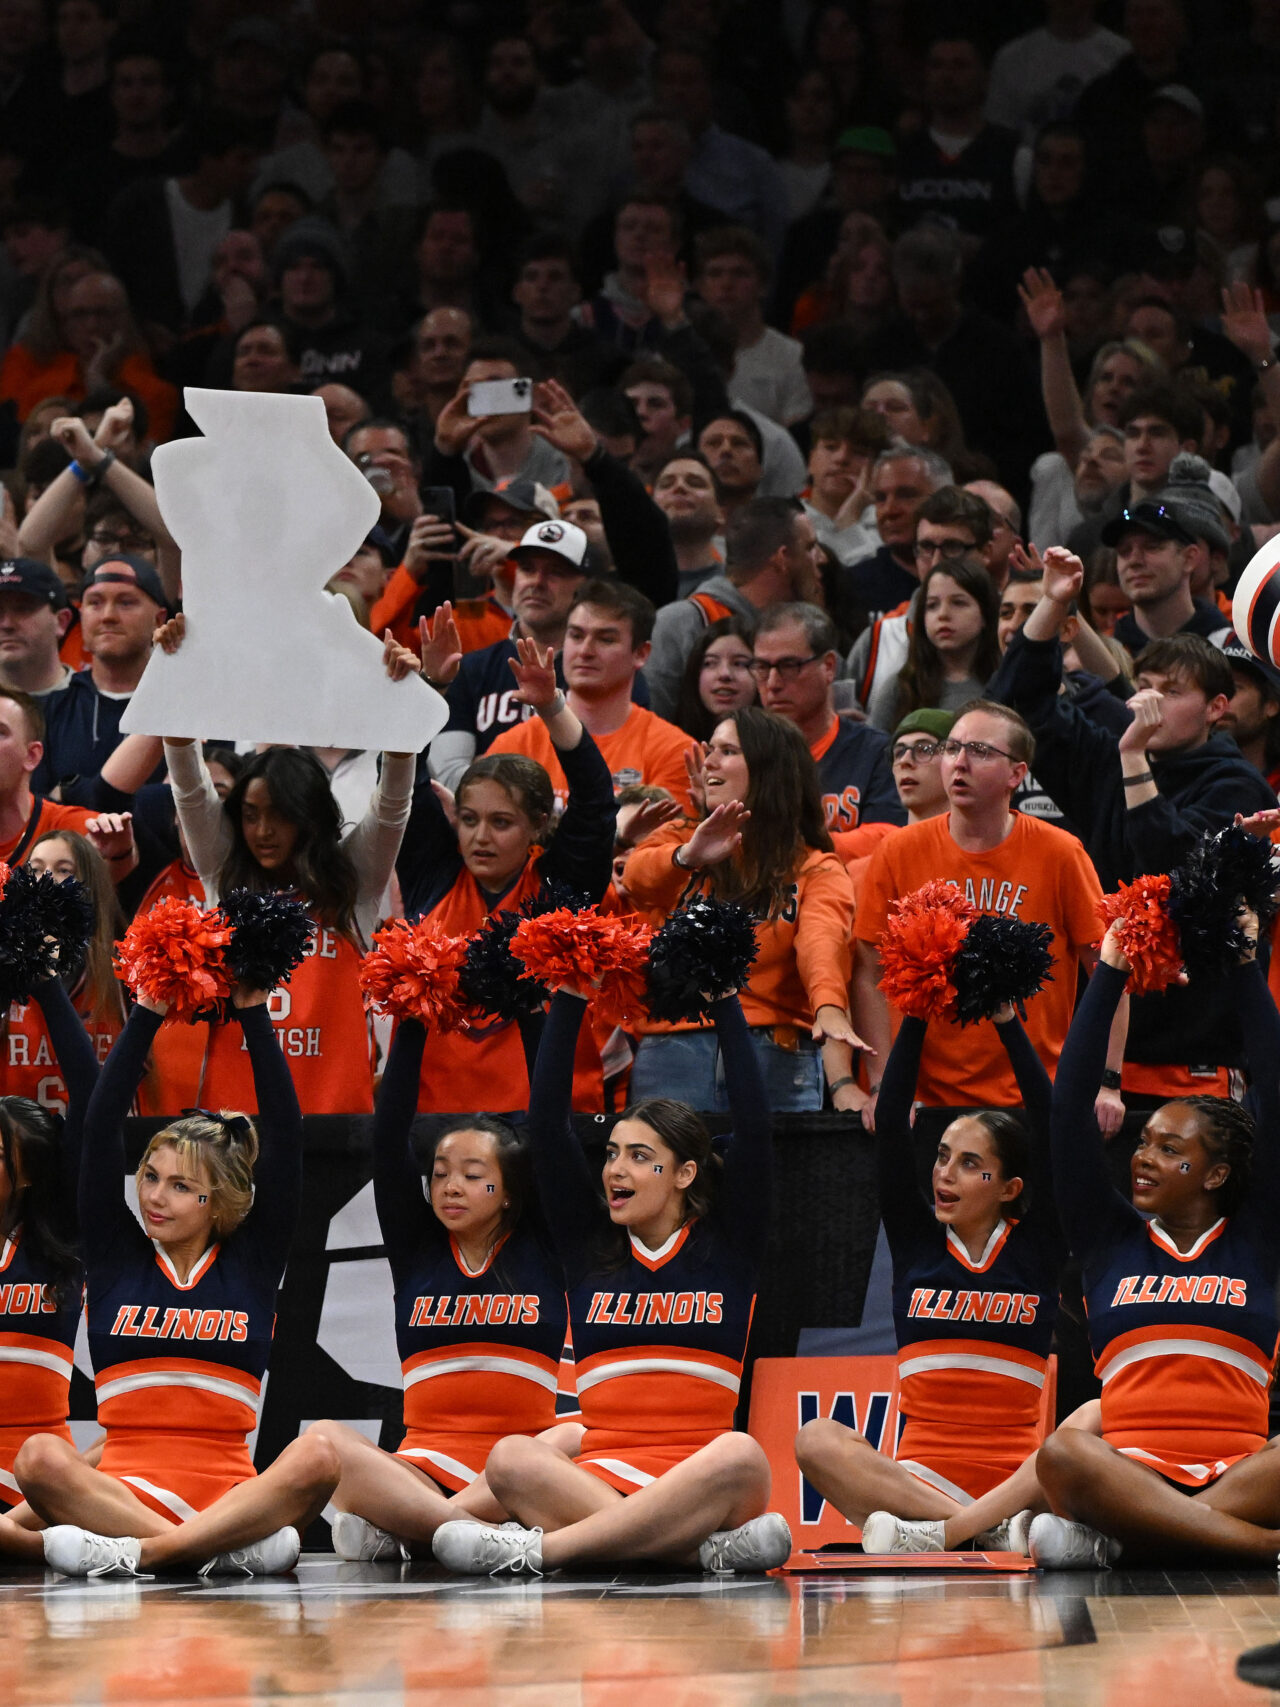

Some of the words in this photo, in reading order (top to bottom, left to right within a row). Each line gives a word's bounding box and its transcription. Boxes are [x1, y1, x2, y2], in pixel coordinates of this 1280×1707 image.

[899, 178, 992, 202] UCONN
[586, 1291, 724, 1325] ILLINOIS
[907, 1288, 1041, 1325] ILLINOIS
[1110, 1275, 1246, 1308] ILLINOIS
[110, 1305, 248, 1342] ILLINOIS
[409, 1294, 540, 1327] ILLINOIS
